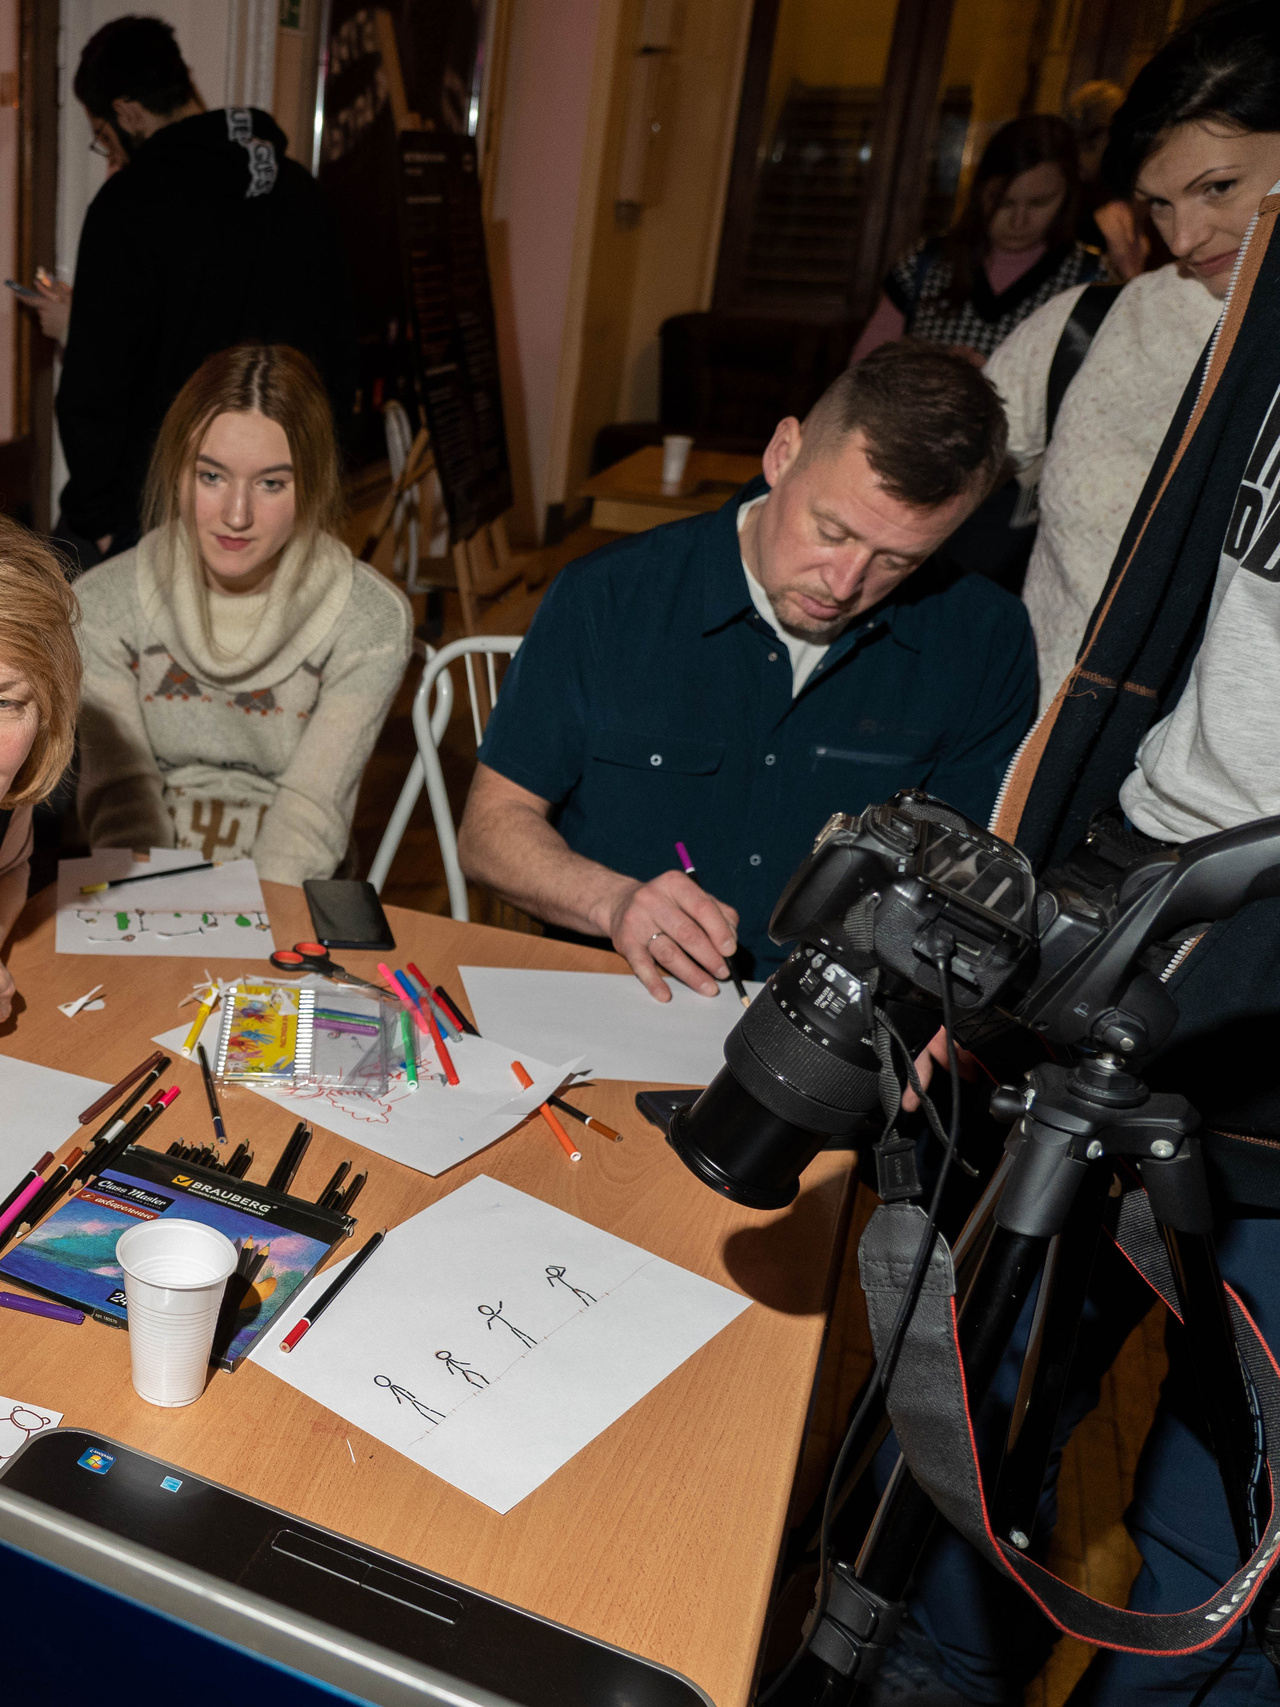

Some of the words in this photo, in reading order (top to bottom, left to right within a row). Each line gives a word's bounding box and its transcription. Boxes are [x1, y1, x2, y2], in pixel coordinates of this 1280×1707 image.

[97, 1180, 128, 1193] Class
[128, 1188, 167, 1206] Master
[191, 1181, 271, 1213] BRAUBERG
[94, 1197, 154, 1220] акварельные
